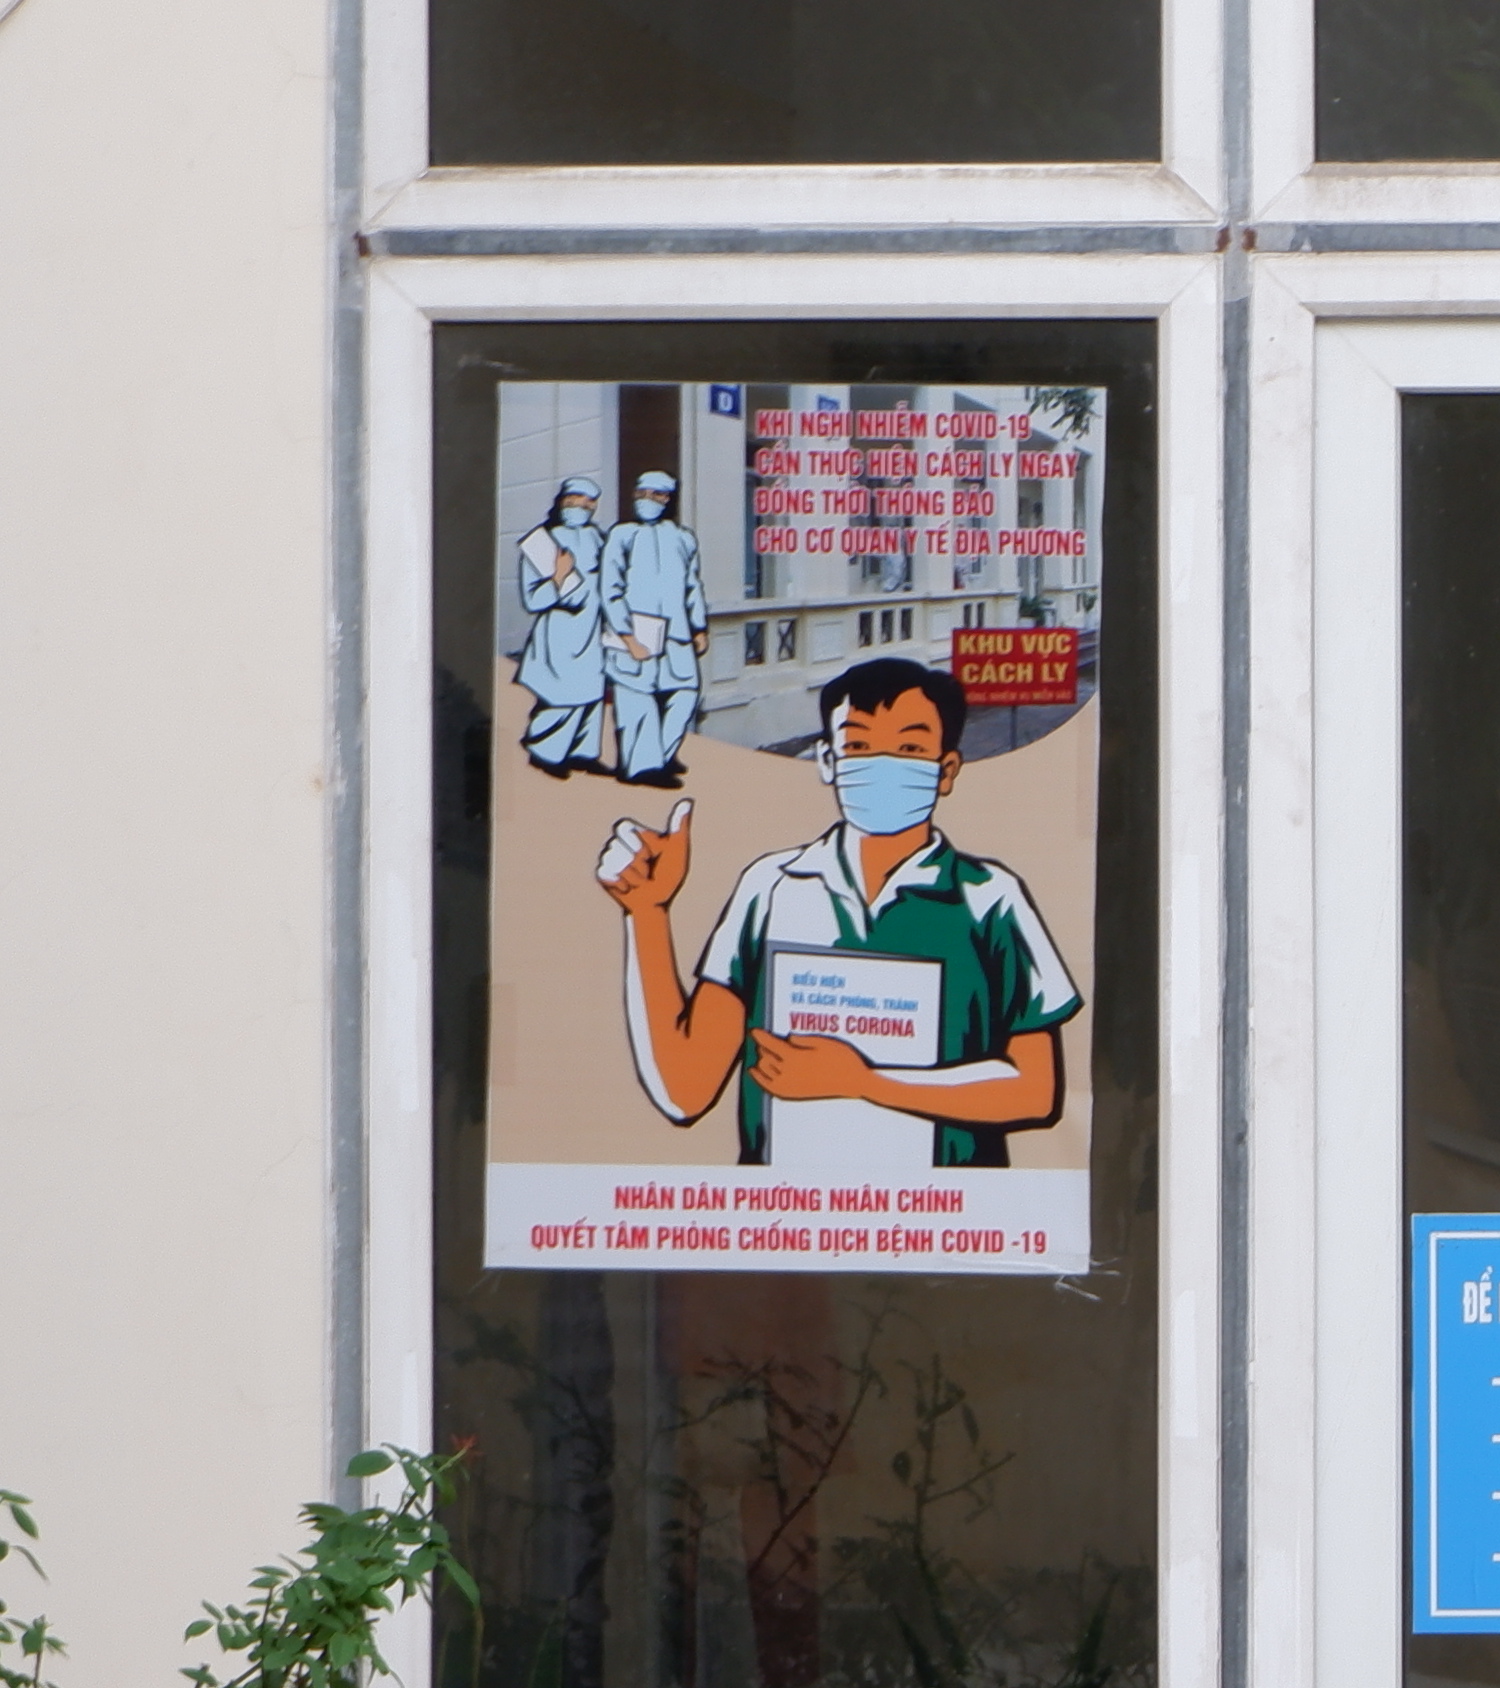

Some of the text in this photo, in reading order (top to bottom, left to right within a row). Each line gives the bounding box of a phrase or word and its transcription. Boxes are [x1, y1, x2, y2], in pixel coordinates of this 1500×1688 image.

[756, 410, 793, 438] KHI
[935, 413, 1032, 439] COVID-19
[867, 443, 918, 482] HIỆN
[926, 445, 984, 478] CÁCH
[990, 452, 1013, 477] LY
[1019, 452, 1079, 478] NGAY
[952, 483, 995, 517] BÁO
[755, 527, 798, 553] CHO
[806, 527, 834, 553] CƠ
[840, 527, 898, 556] QUAN
[903, 529, 918, 554] Y
[926, 520, 951, 555] TẾ
[955, 528, 990, 561] ĐỊA
[959, 633, 1014, 655] KHU
[961, 658, 1069, 684] CÁCH LY
[789, 1011, 915, 1038] VIRUS CORONA
[614, 1184, 674, 1212] NHÂN
[682, 1184, 728, 1212] DÂN
[829, 1185, 890, 1213] NHÂN
[896, 1184, 964, 1214] CHÍNH
[531, 1216, 597, 1250] QUYẾT
[604, 1225, 649, 1250] TÂM
[738, 1219, 812, 1252] CHỐNG
[819, 1228, 869, 1257] DỊCH
[877, 1223, 934, 1258] BỆNH
[942, 1229, 1003, 1253] COVID
[1011, 1229, 1047, 1254] -19
[1463, 1266, 1493, 1323] ĐỂ
